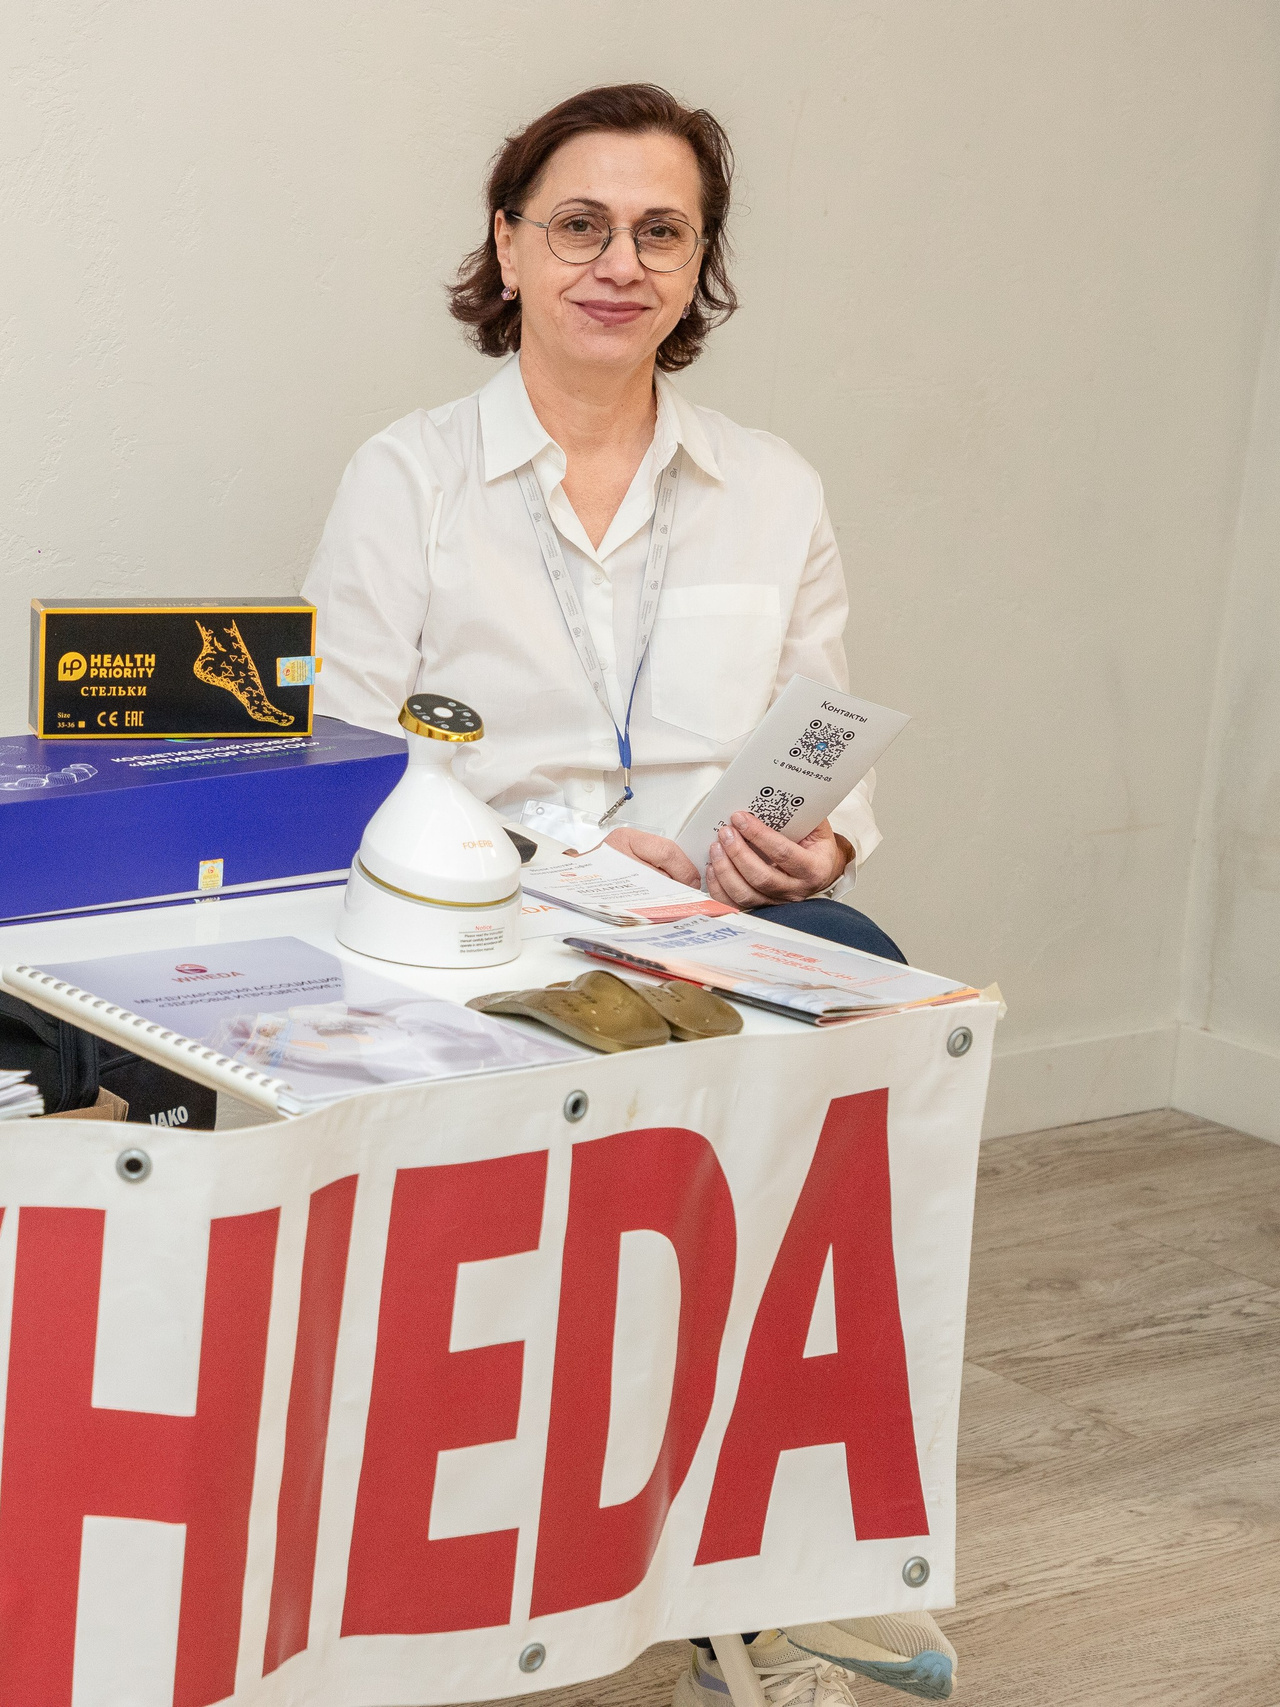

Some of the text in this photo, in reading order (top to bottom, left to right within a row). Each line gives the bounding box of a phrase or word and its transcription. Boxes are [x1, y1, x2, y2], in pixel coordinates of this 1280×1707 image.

[90, 653, 156, 668] HEALTH
[90, 667, 155, 679] PRIORITY
[80, 685, 148, 697] СТЕЛЬКИ
[820, 700, 868, 724] Контакты
[110, 737, 303, 763] КОСМЕТИЧЕСКИЙ ПРИБОР
[462, 839, 494, 850] FOHERB
[172, 971, 246, 983] WHIEDA
[134, 976, 342, 1004] МЕЖДУНАРОДНАЯ АССОЦИАЦИЯ
[150, 1105, 189, 1128] JAKO
